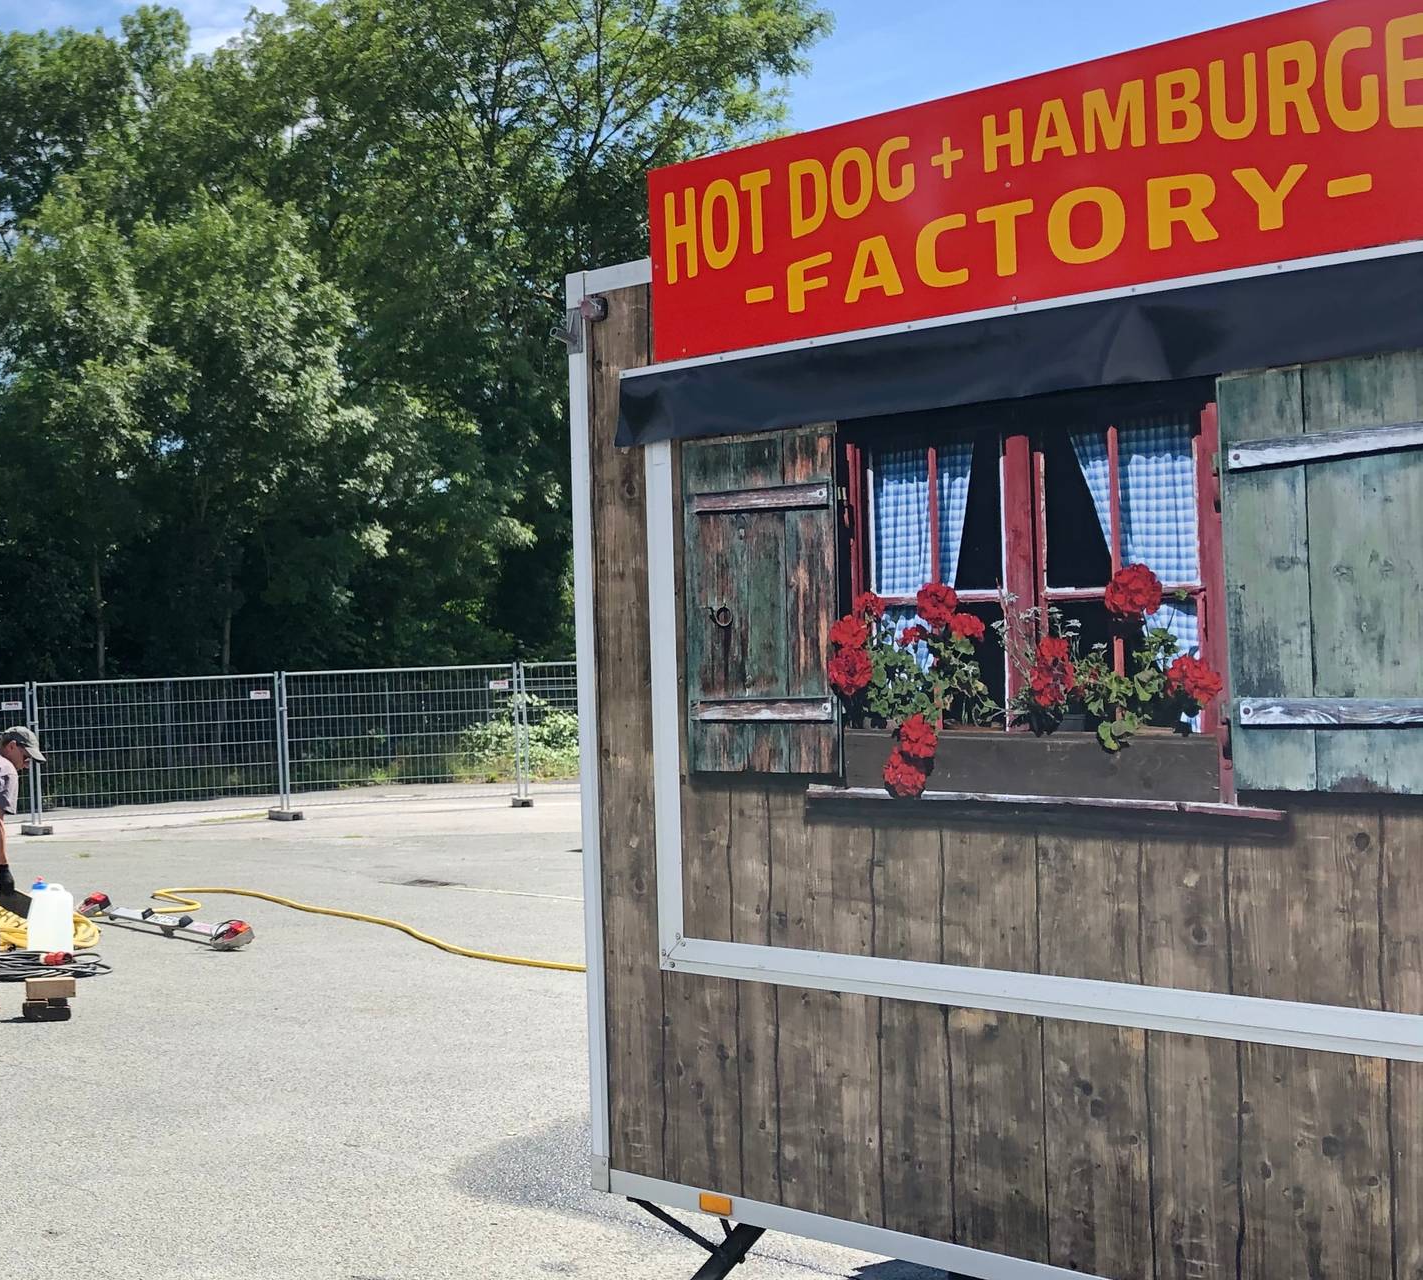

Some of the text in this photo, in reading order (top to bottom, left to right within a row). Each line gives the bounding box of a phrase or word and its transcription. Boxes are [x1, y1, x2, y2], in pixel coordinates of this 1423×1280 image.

[664, 12, 1423, 285] HOT DOG + HAMBURGE
